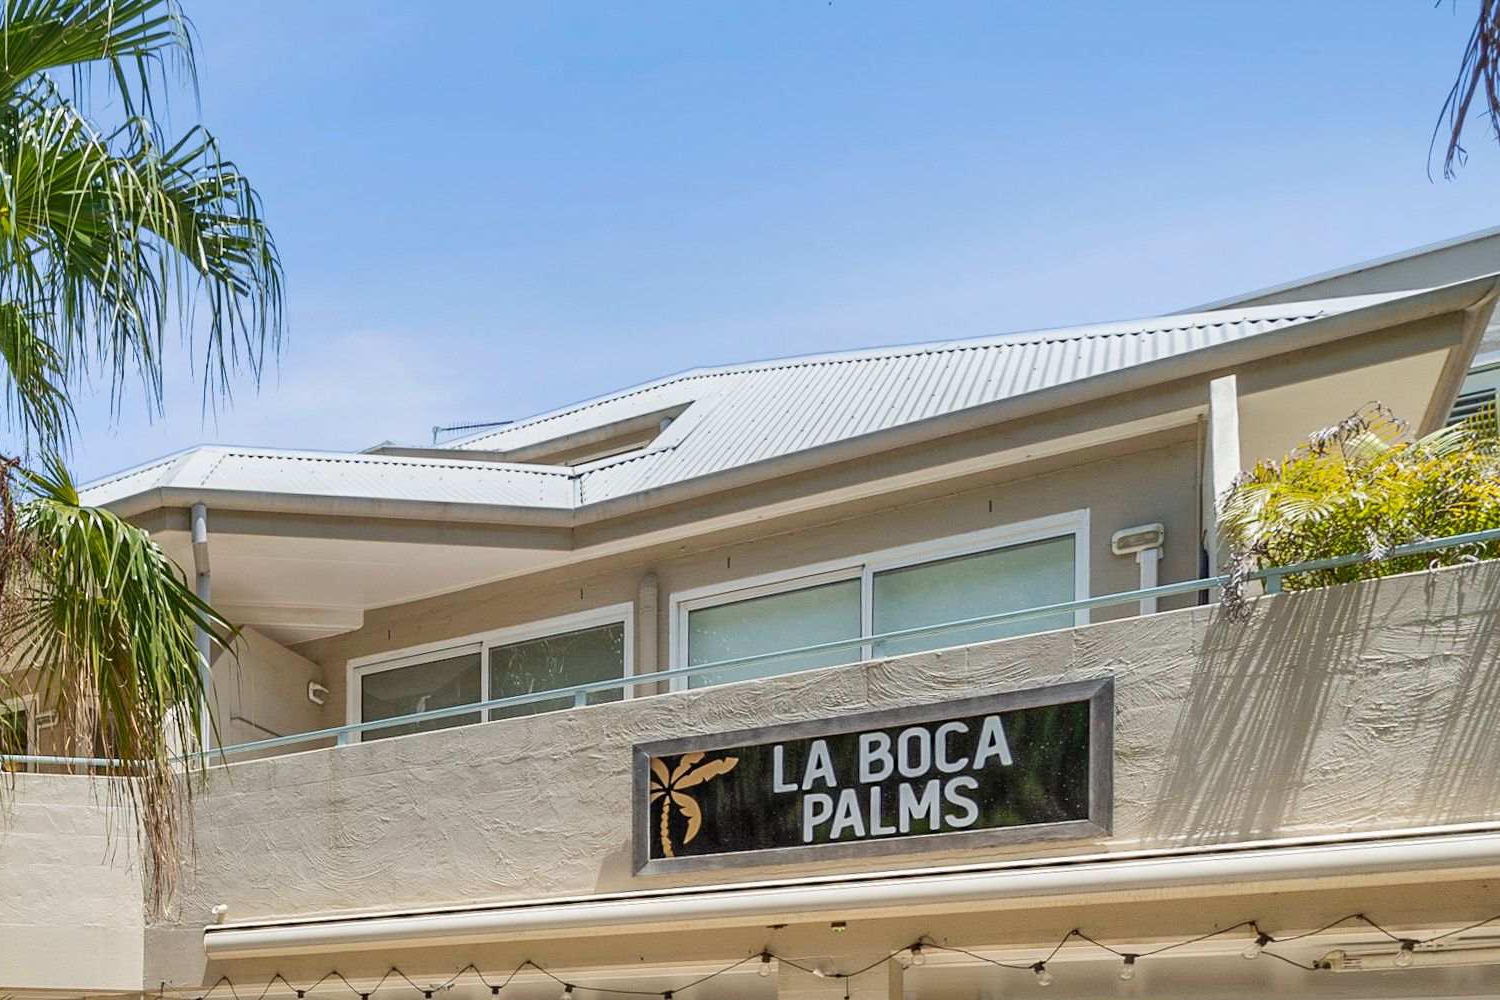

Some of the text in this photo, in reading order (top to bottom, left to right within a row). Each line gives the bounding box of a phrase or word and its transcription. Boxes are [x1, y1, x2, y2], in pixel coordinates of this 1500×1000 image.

[773, 715, 1014, 794] LA BOCA
[802, 776, 981, 844] PALMS
